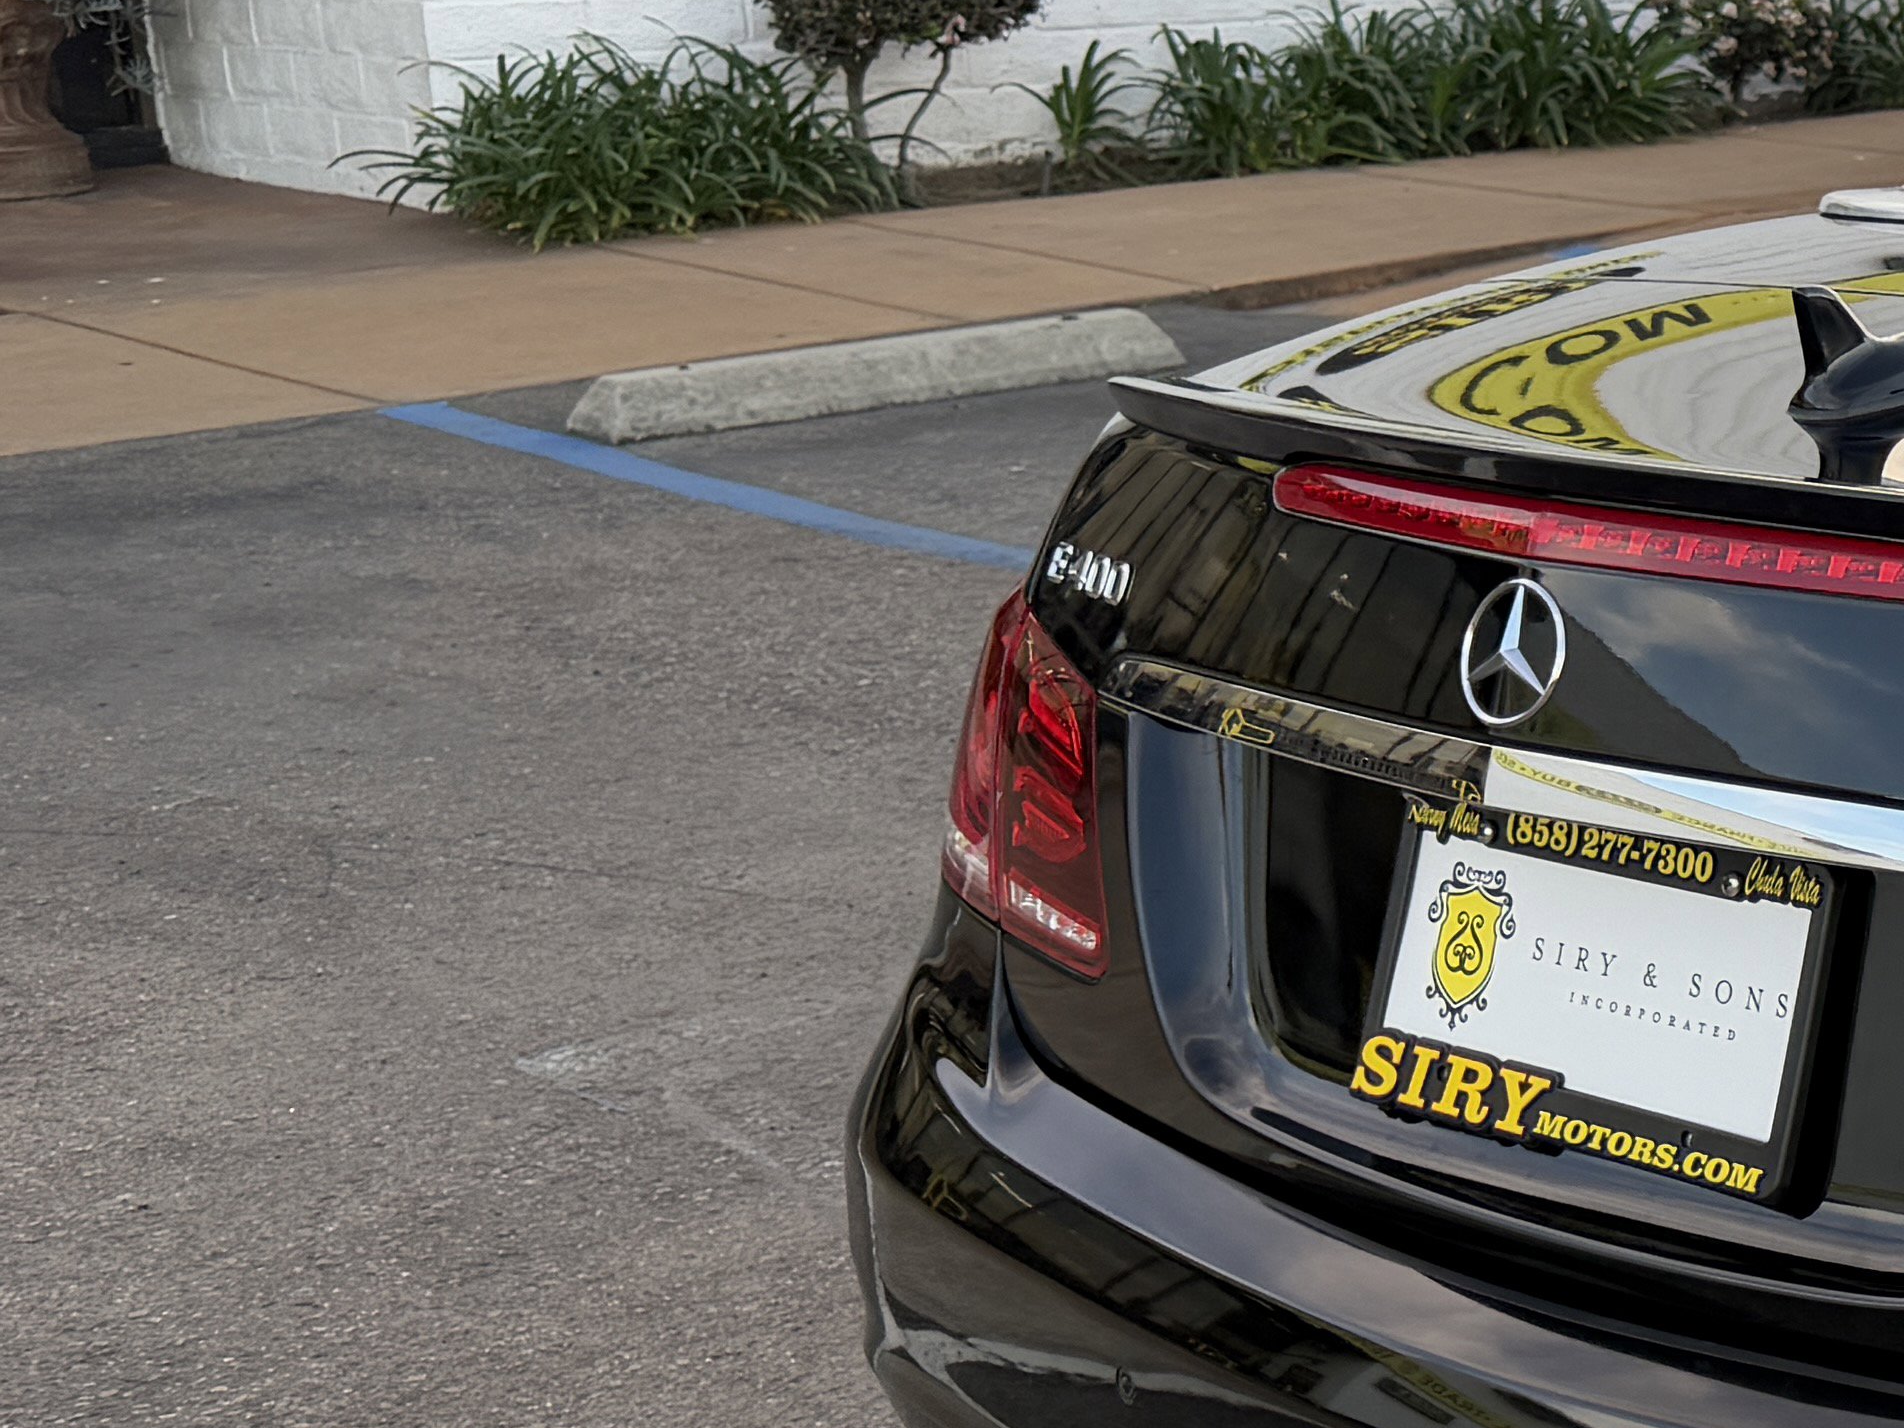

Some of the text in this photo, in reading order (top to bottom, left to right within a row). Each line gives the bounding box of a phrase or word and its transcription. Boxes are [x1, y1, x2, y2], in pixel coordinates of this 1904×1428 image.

[1506, 812, 1714, 884] (858) 277-7300
[1532, 937, 1789, 1019] SIRY & SONS
[1569, 991, 1737, 1041] INCORPORATED
[1350, 1035, 1551, 1137] SIRY
